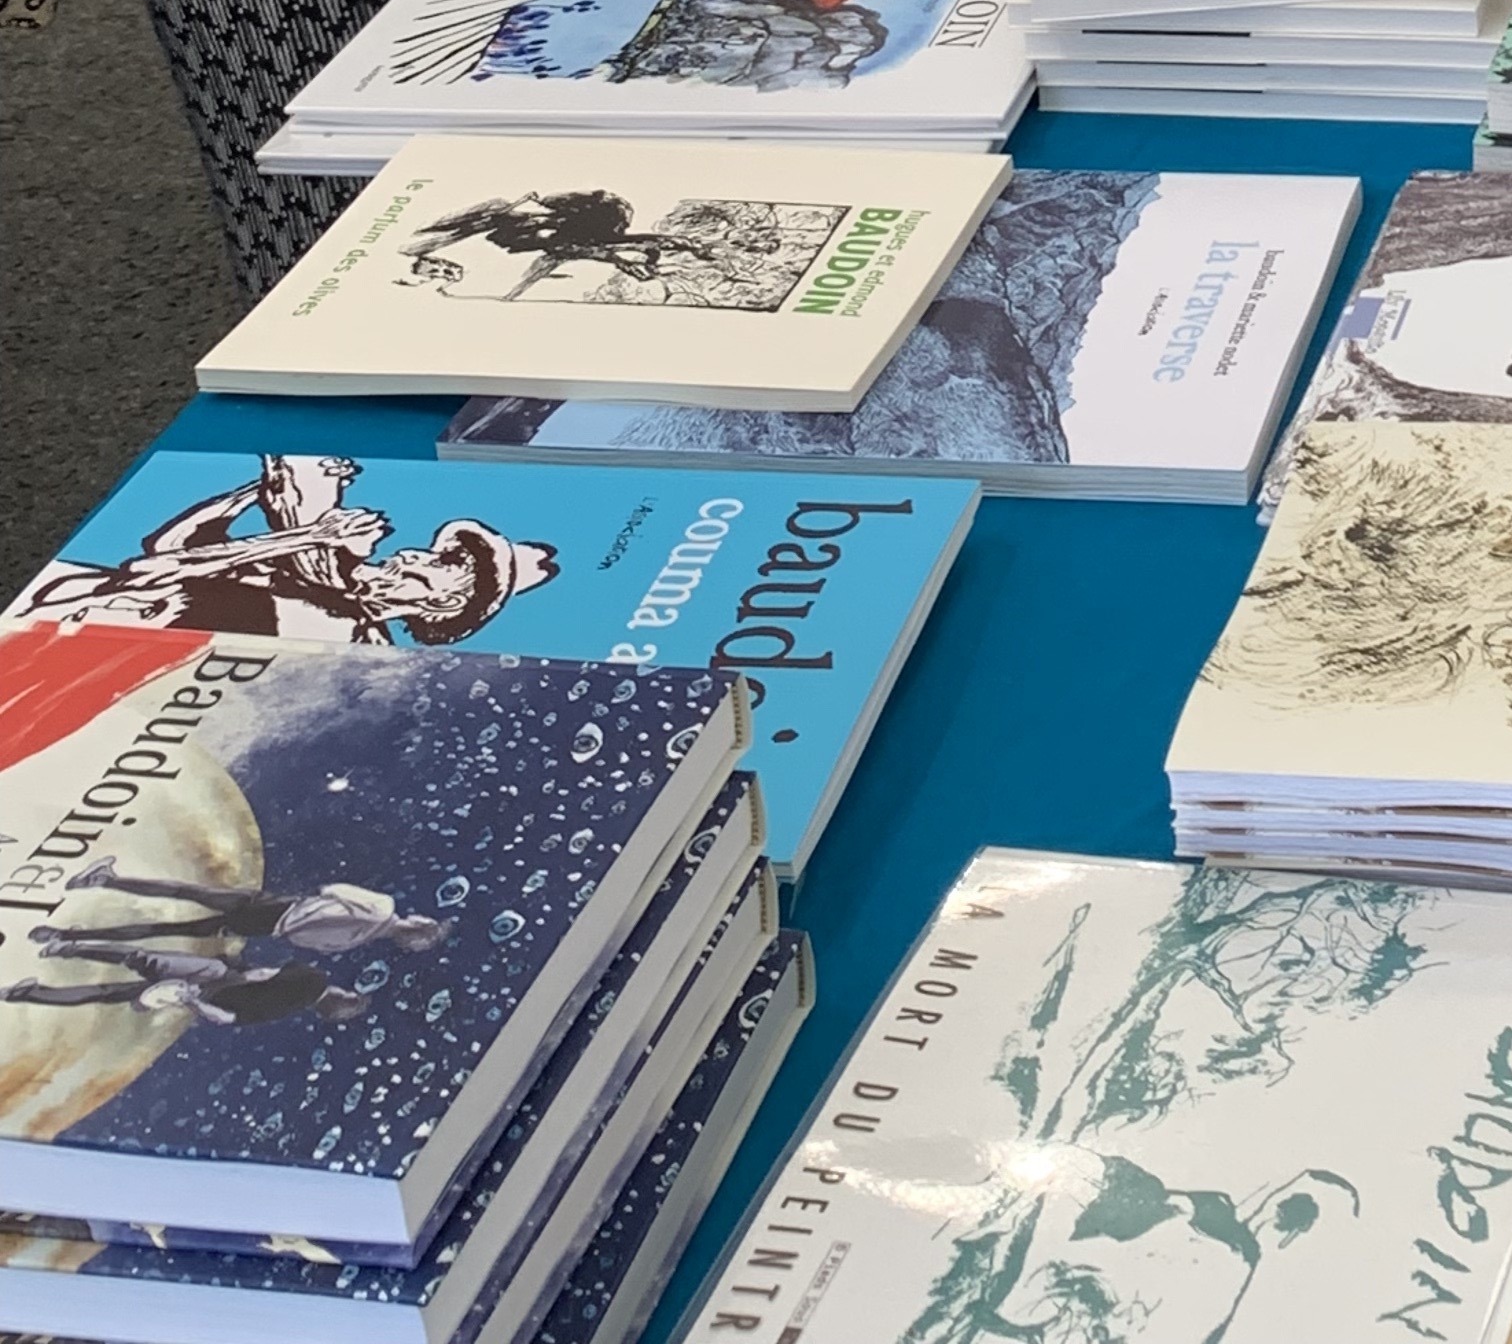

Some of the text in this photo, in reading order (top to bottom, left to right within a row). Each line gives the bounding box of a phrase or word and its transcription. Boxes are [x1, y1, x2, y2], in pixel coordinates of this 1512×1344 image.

[291, 179, 434, 317] le parfum des olives
[792, 207, 904, 315] BAUDOIN
[840, 209, 932, 318] hugues et edmond
[1152, 240, 1260, 383] la traverse
[626, 497, 745, 631] couma
[709, 498, 913, 742] baud
[27, 647, 278, 861] Baudoin
[883, 947, 979, 1051] MORT
[832, 1081, 899, 1133] DU
[709, 1167, 847, 1333] PEINTR
